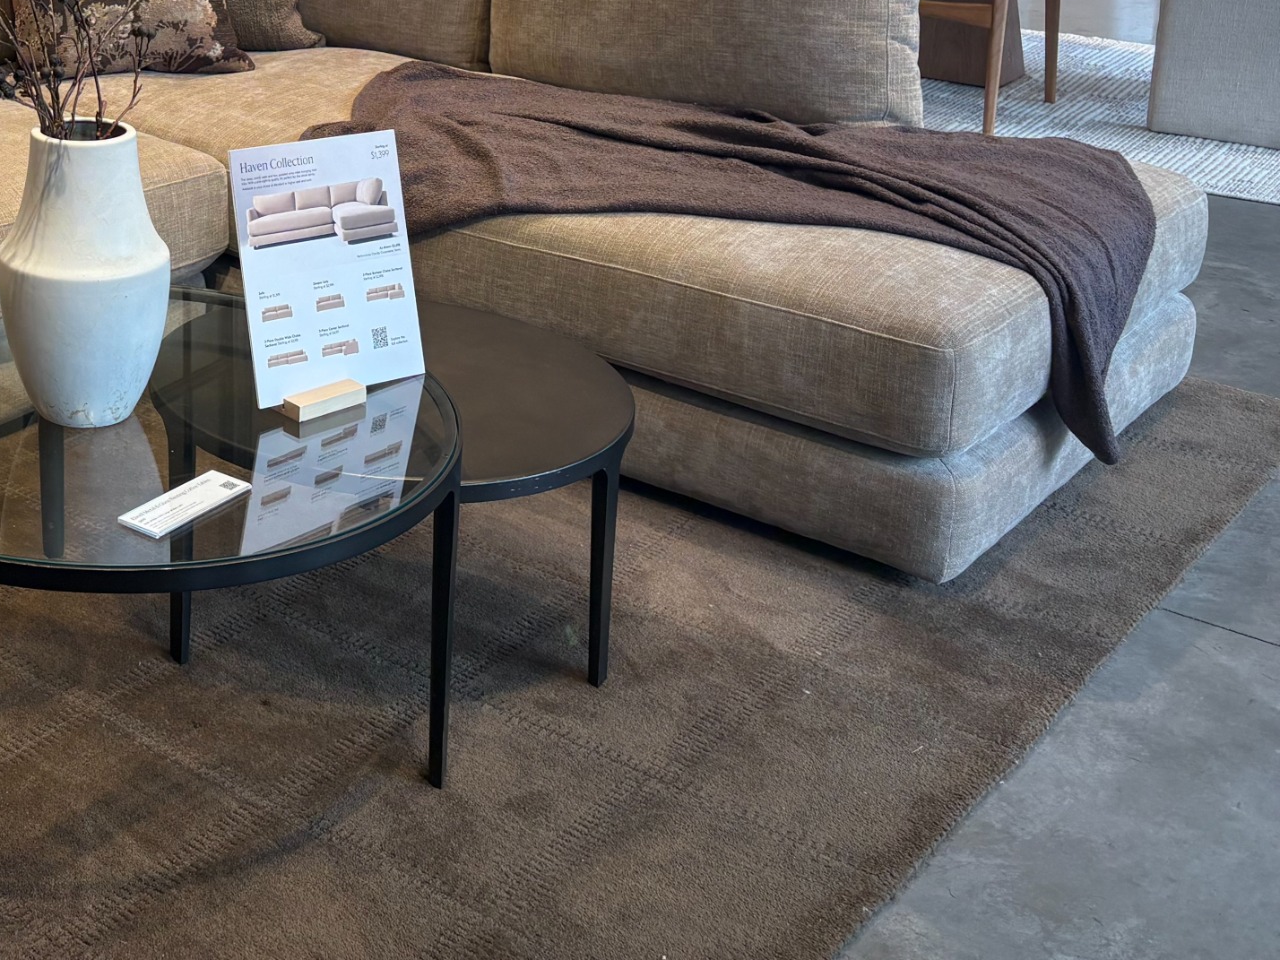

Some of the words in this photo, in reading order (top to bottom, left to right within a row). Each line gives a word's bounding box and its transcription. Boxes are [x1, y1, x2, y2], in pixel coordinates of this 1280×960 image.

[371, 149, 389, 160] $1,399
[239, 162, 268, 174] Haven
[269, 155, 314, 171] Collection
